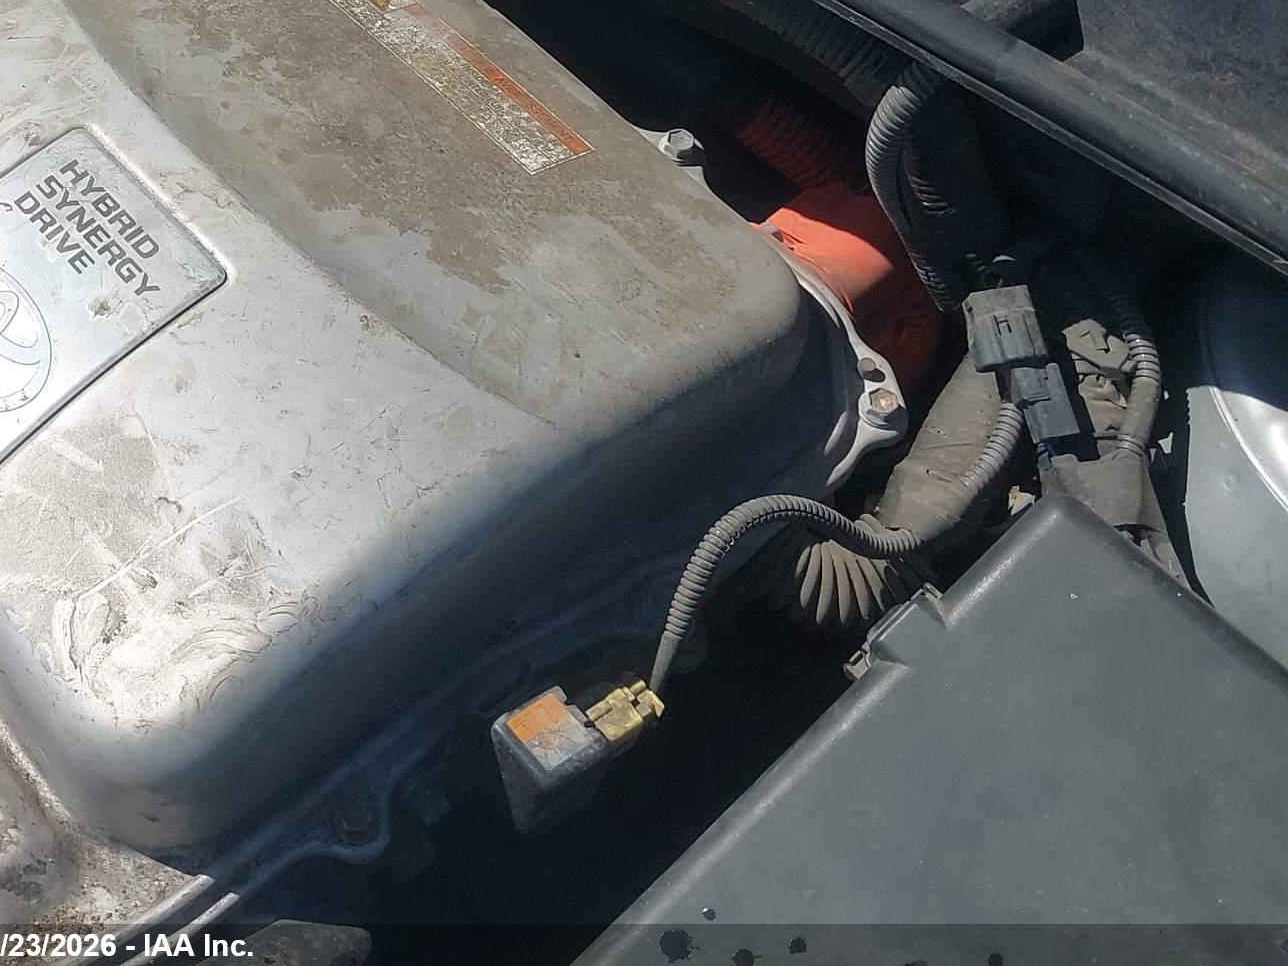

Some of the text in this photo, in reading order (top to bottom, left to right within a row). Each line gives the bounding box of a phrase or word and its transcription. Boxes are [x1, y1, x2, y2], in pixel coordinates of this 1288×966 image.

[14, 191, 95, 274] DRIVE
[35, 175, 161, 296] SYNERGY
[60, 159, 160, 259] HYBRID
